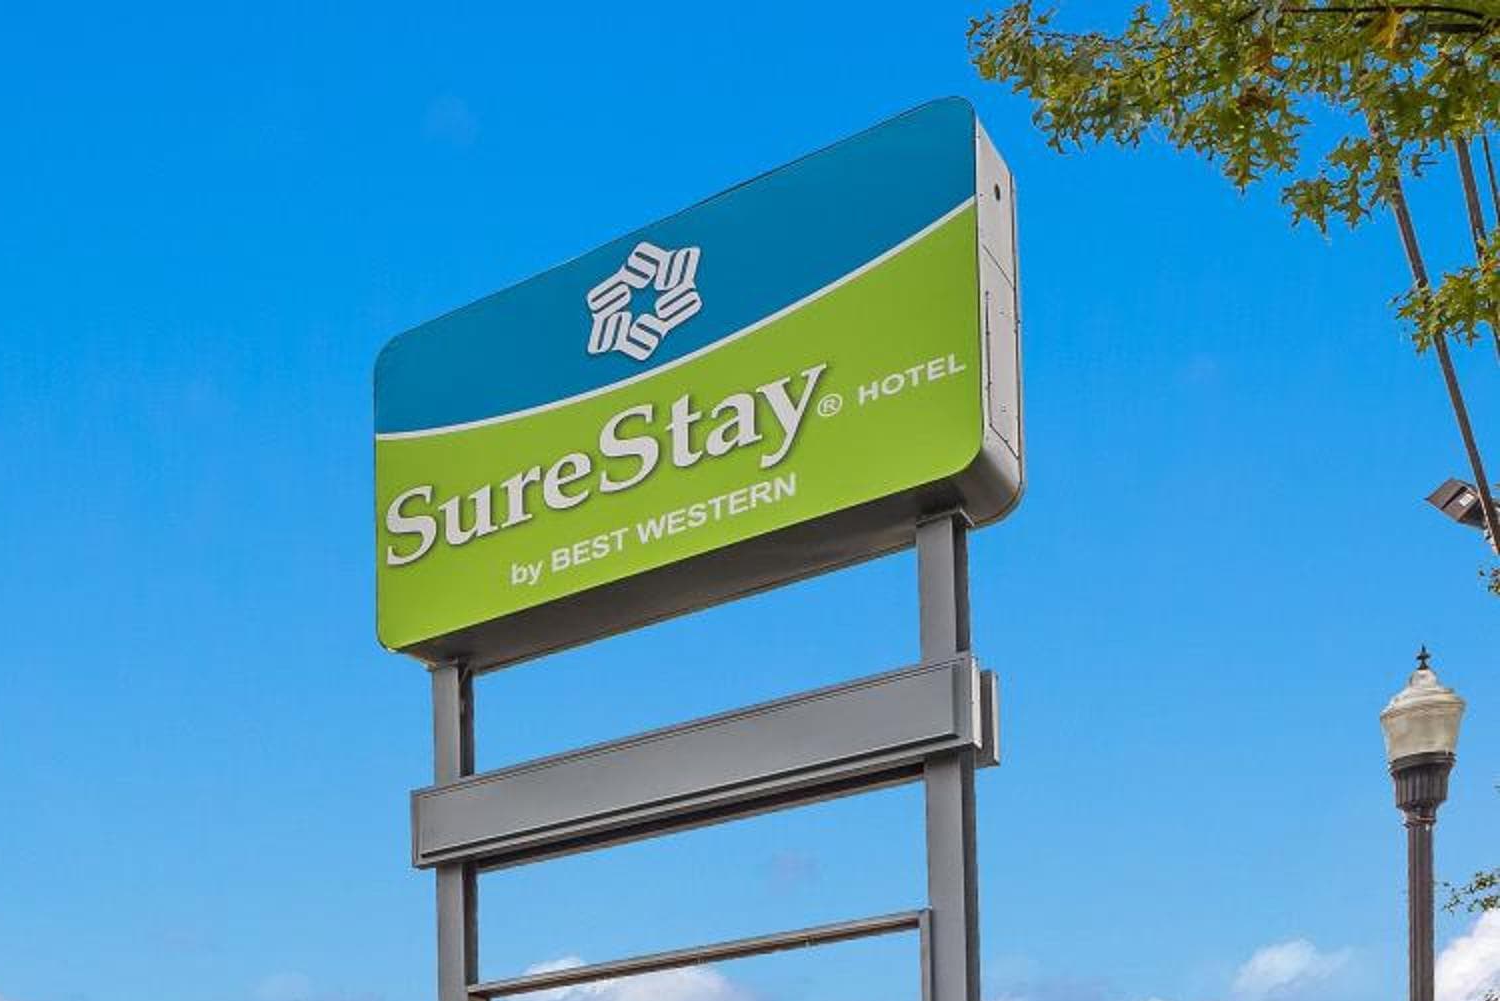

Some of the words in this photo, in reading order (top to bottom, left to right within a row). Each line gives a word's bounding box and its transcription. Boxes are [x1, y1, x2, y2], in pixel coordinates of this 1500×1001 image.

[858, 353, 967, 405] HOTEL
[511, 561, 543, 586] by
[551, 528, 629, 573] BEST
[636, 473, 797, 545] WESTERN
